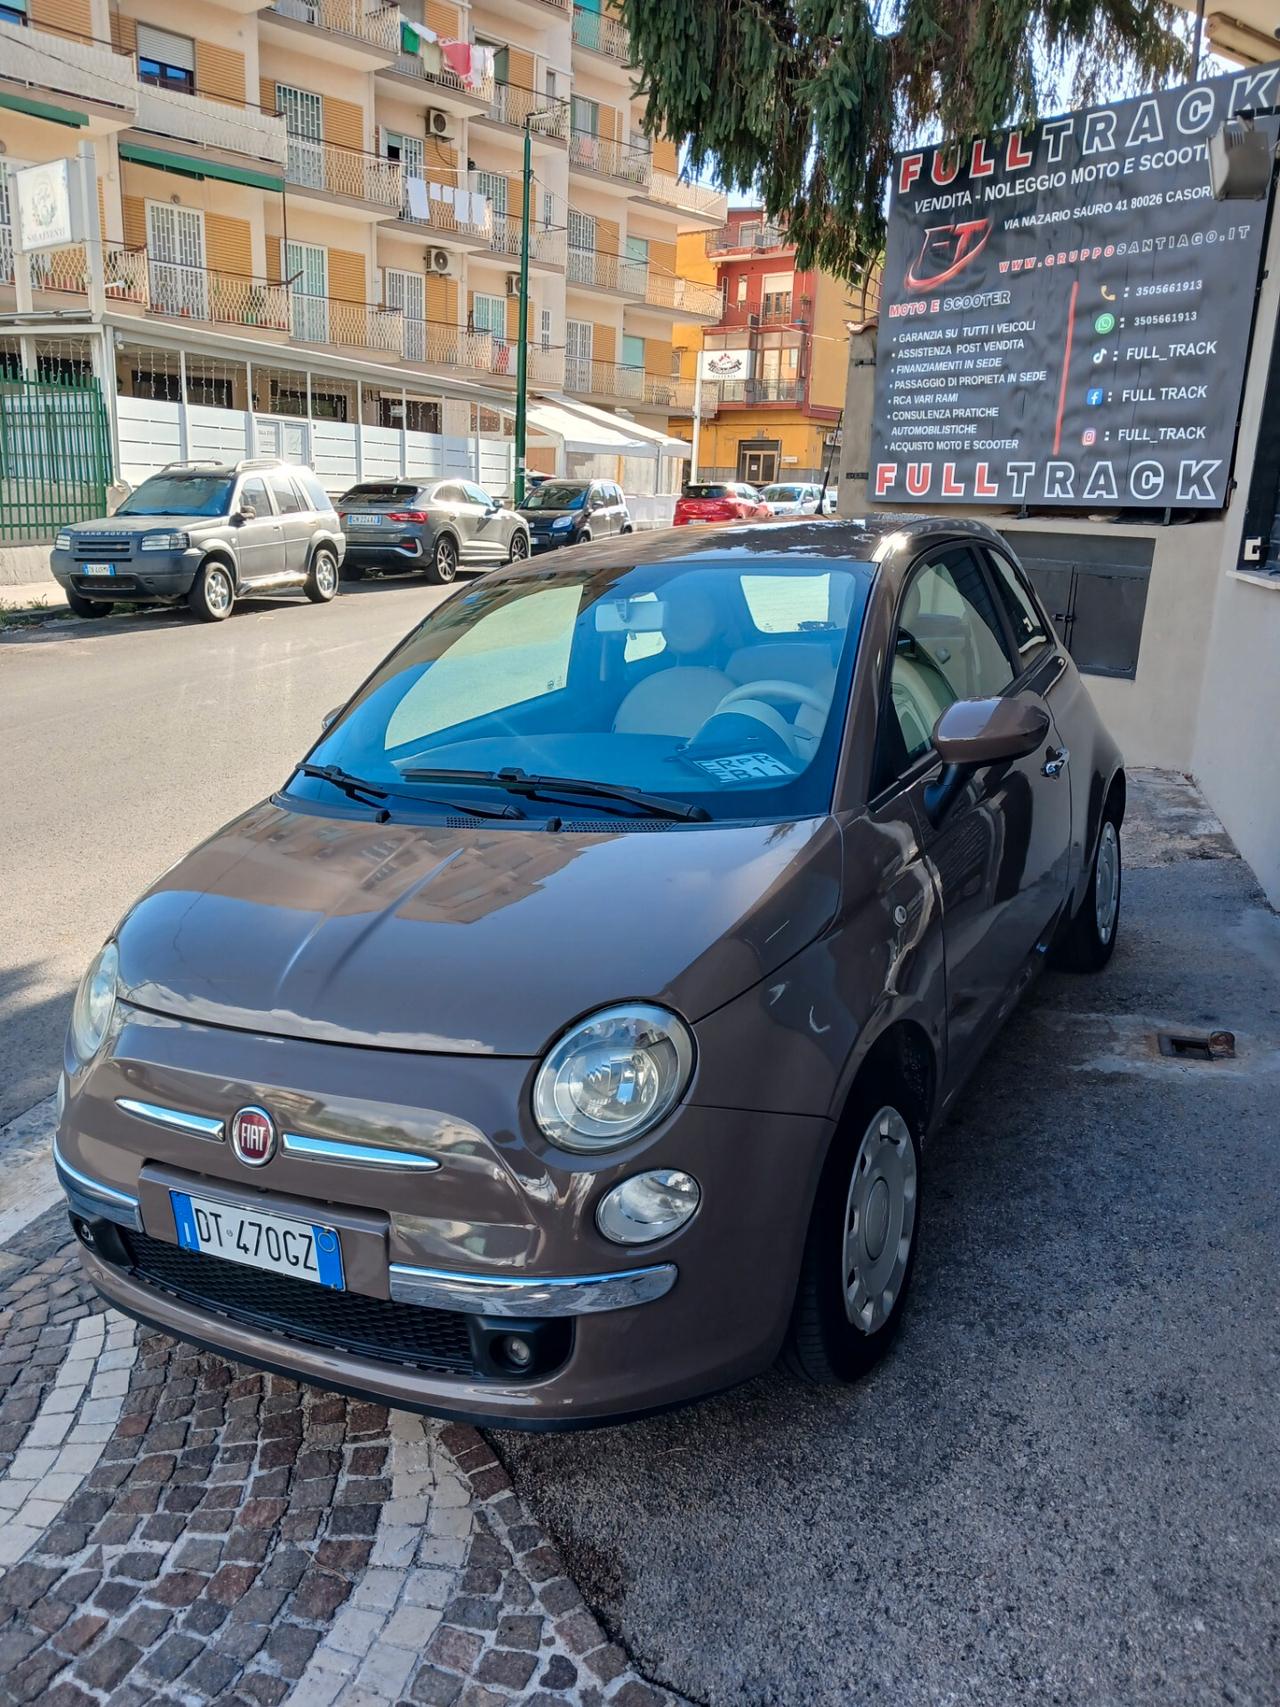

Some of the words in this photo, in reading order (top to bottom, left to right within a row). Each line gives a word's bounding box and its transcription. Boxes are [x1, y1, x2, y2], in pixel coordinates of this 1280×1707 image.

[914, 190, 972, 214] VENDITA
[985, 172, 1066, 201] NOLEGGIO
[1070, 161, 1119, 185] MOTO
[1123, 157, 1136, 175] E
[1004, 218, 1020, 230] VIA
[1021, 209, 1070, 227] NAZARIO
[1073, 202, 1113, 219] SAURO
[1115, 199, 1128, 211] 41
[1131, 193, 1163, 209] 80026
[1165, 185, 1213, 203] CASOR
[1136, 279, 1203, 297] 3505661913
[888, 301, 927, 318] MOTO
[930, 299, 941, 313] E
[943, 290, 1011, 312] SCOOTER
[1133, 311, 1198, 326] 3505661913
[898, 329, 943, 343] GARANZIA
[945, 328, 959, 338] SU
[962, 325, 989, 337] TUTTI
[996, 320, 1036, 334] VEICOLI
[897, 345, 952, 359] ASSISTENZA
[956, 342, 982, 354] POST
[983, 338, 1025, 352] VENDITA
[896, 360, 963, 374] FINANZIAMENTI
[964, 359, 975, 369] IN
[976, 357, 1003, 369] SEDE
[894, 377, 946, 390] PASSAGGIO
[947, 377, 957, 387] DI
[959, 373, 1006, 386] PROPIETA
[1007, 372, 1017, 383] IN
[1019, 370, 1047, 382] SEDE
[893, 395, 912, 405] RCA
[914, 394, 934, 404] VARI
[935, 392, 959, 403] RAMI
[1122, 388, 1156, 403] FULL
[1160, 385, 1208, 400] TRACK
[892, 409, 951, 421] CONSULENZA
[952, 407, 1000, 419] PRATICHE
[891, 424, 978, 436] AUTOMOBILISTICHE
[889, 441, 934, 453] ACQUISTO
[936, 440, 962, 450] MOTO
[964, 440, 971, 450] E
[972, 439, 1019, 450] SCOOTER
[241, 1122, 266, 1151] FIAT
[194, 1208, 223, 1247] DT
[236, 1220, 317, 1271] 470GZ
